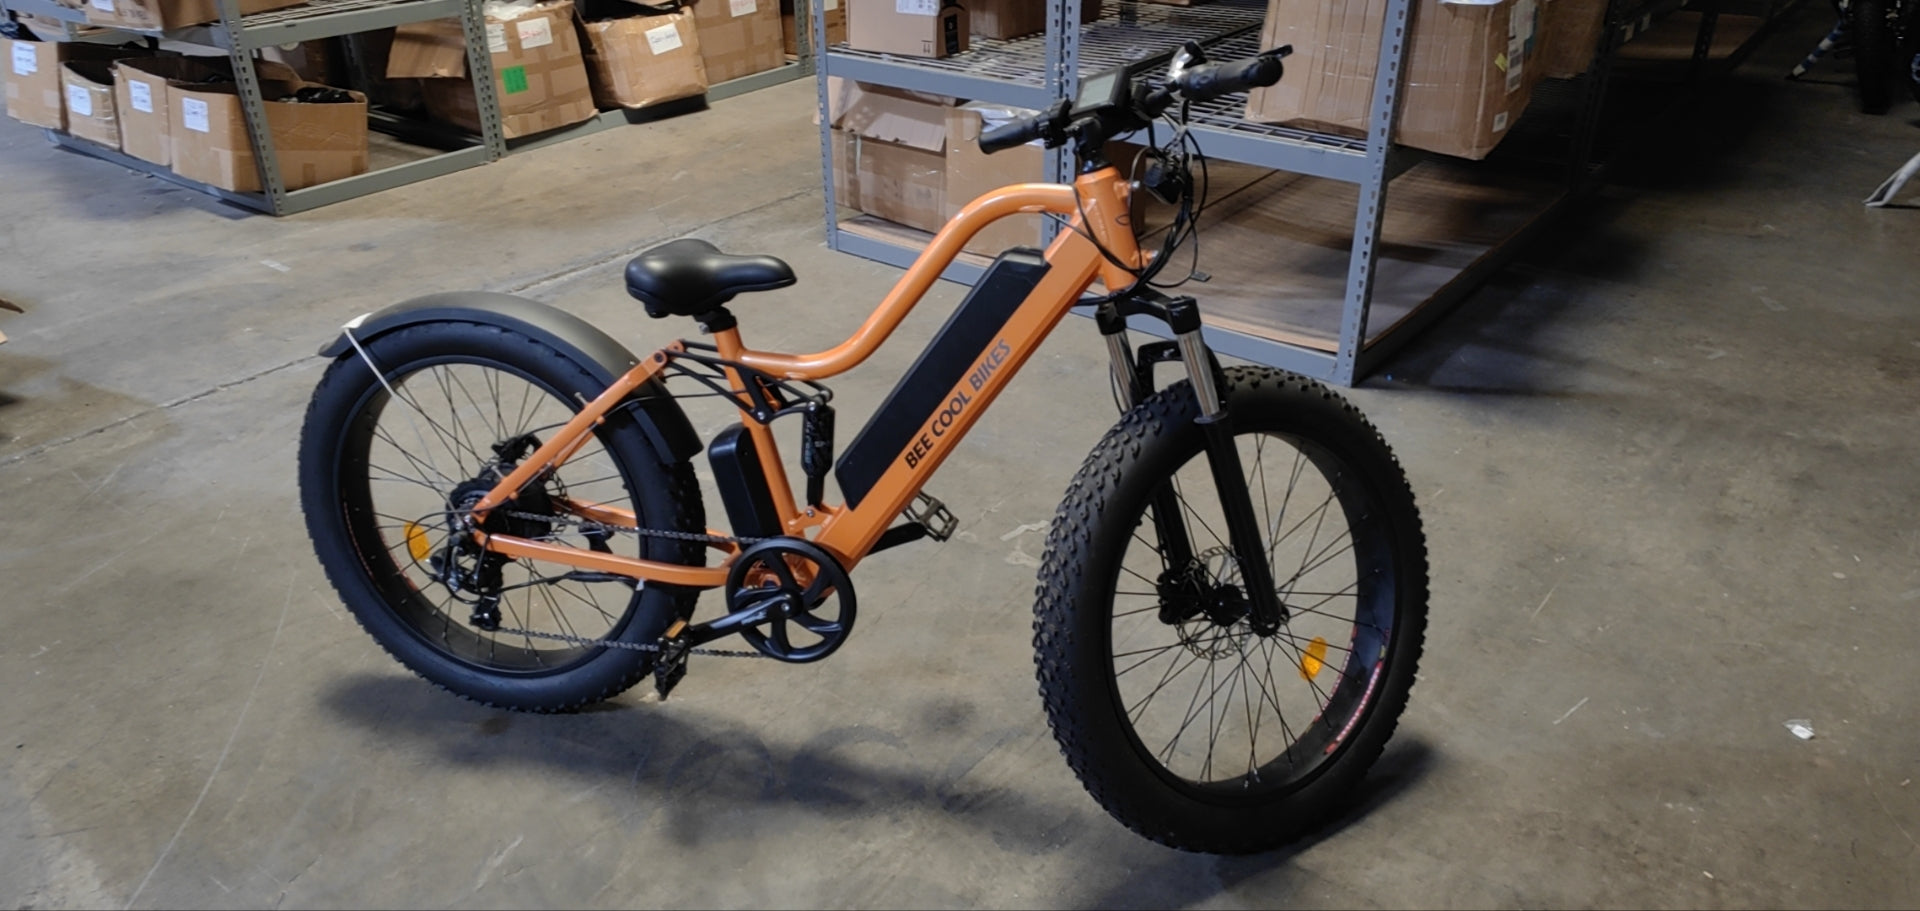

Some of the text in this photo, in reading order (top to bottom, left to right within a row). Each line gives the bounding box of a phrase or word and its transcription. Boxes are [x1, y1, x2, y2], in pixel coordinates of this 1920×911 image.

[904, 339, 1011, 469] BEE COOL BIKES
